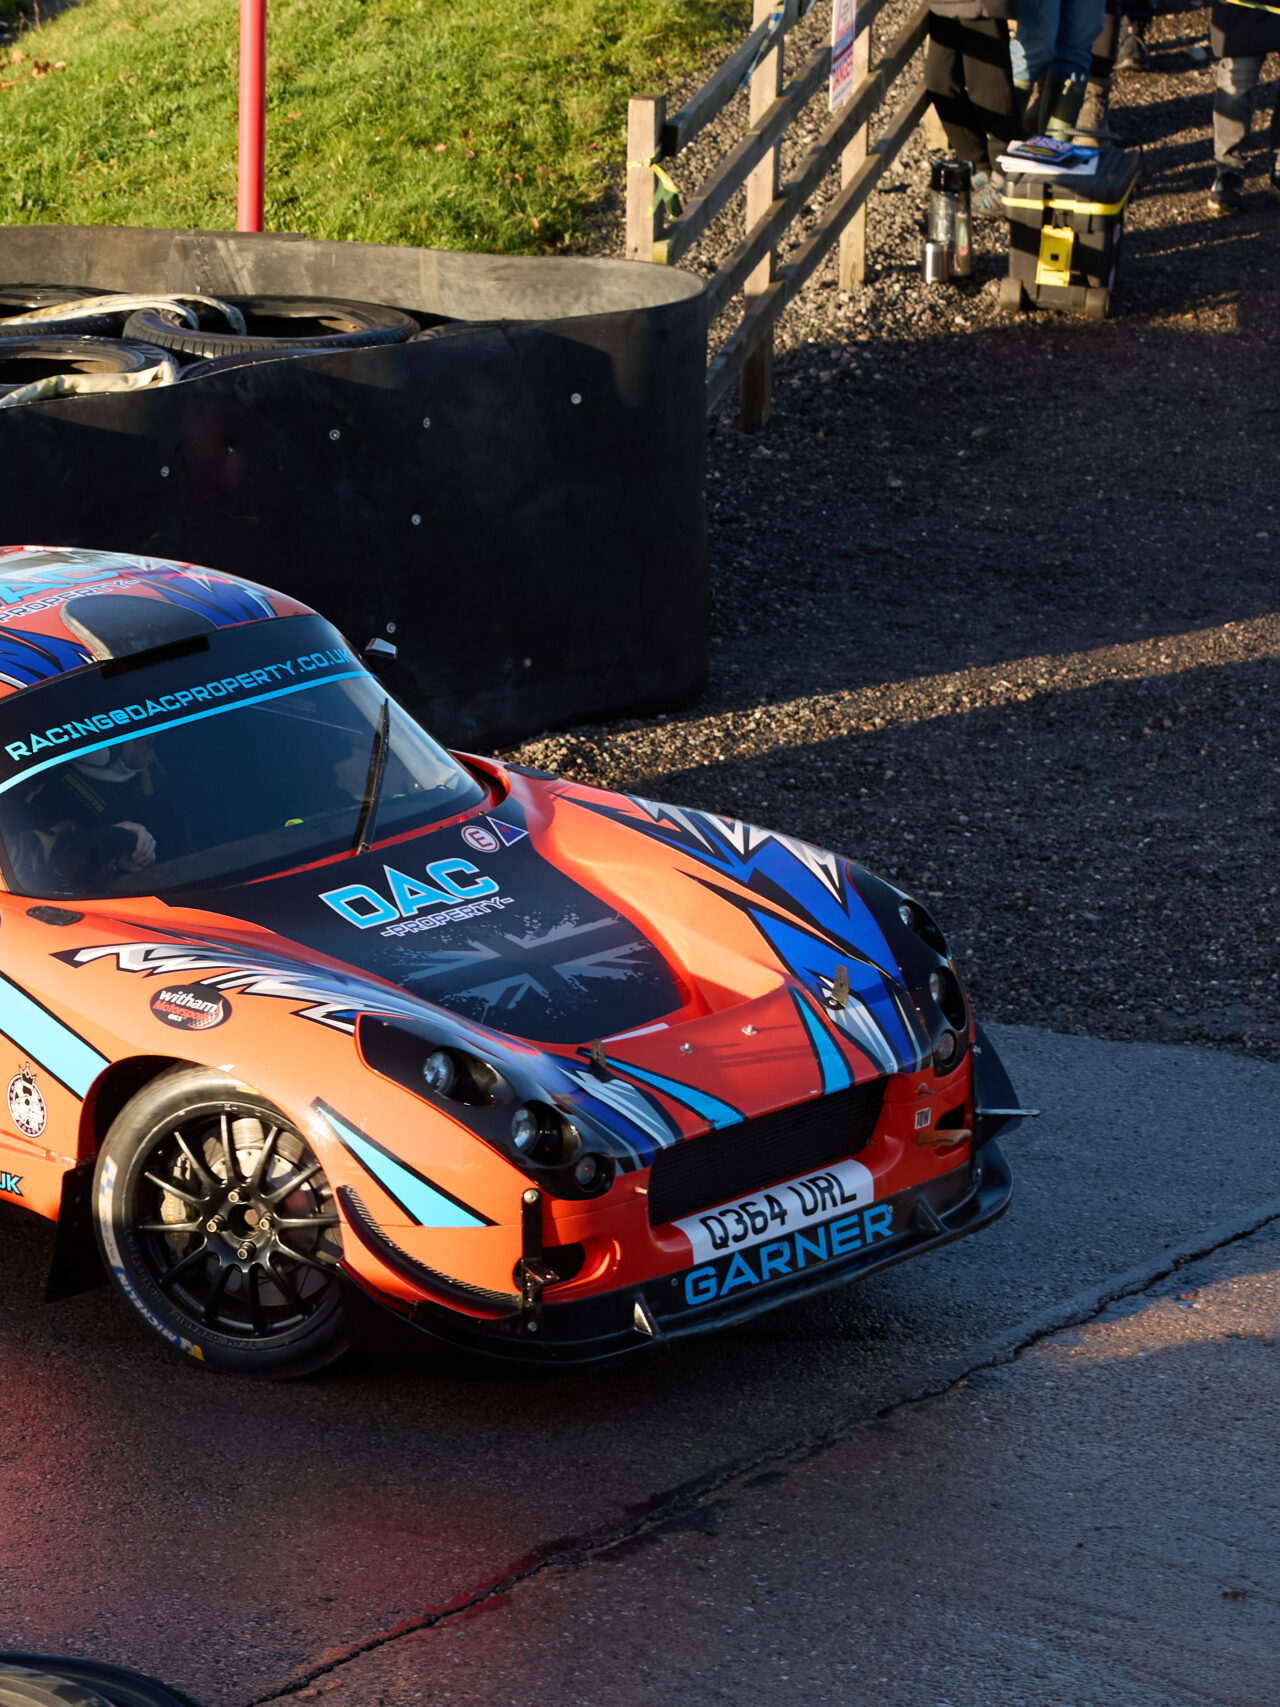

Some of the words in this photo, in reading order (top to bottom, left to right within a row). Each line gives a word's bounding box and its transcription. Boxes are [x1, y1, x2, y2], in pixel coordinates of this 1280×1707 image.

[4, 648, 352, 762] RACING@DACPROPERTY.CO.UK
[468, 830, 494, 848] E
[318, 857, 500, 930] DAC
[159, 990, 218, 1013] witham
[699, 1194, 789, 1251] Q364
[789, 1168, 858, 1216] URL
[684, 1203, 895, 1306] GARNER
[117, 1272, 178, 1342] MICHELIN
